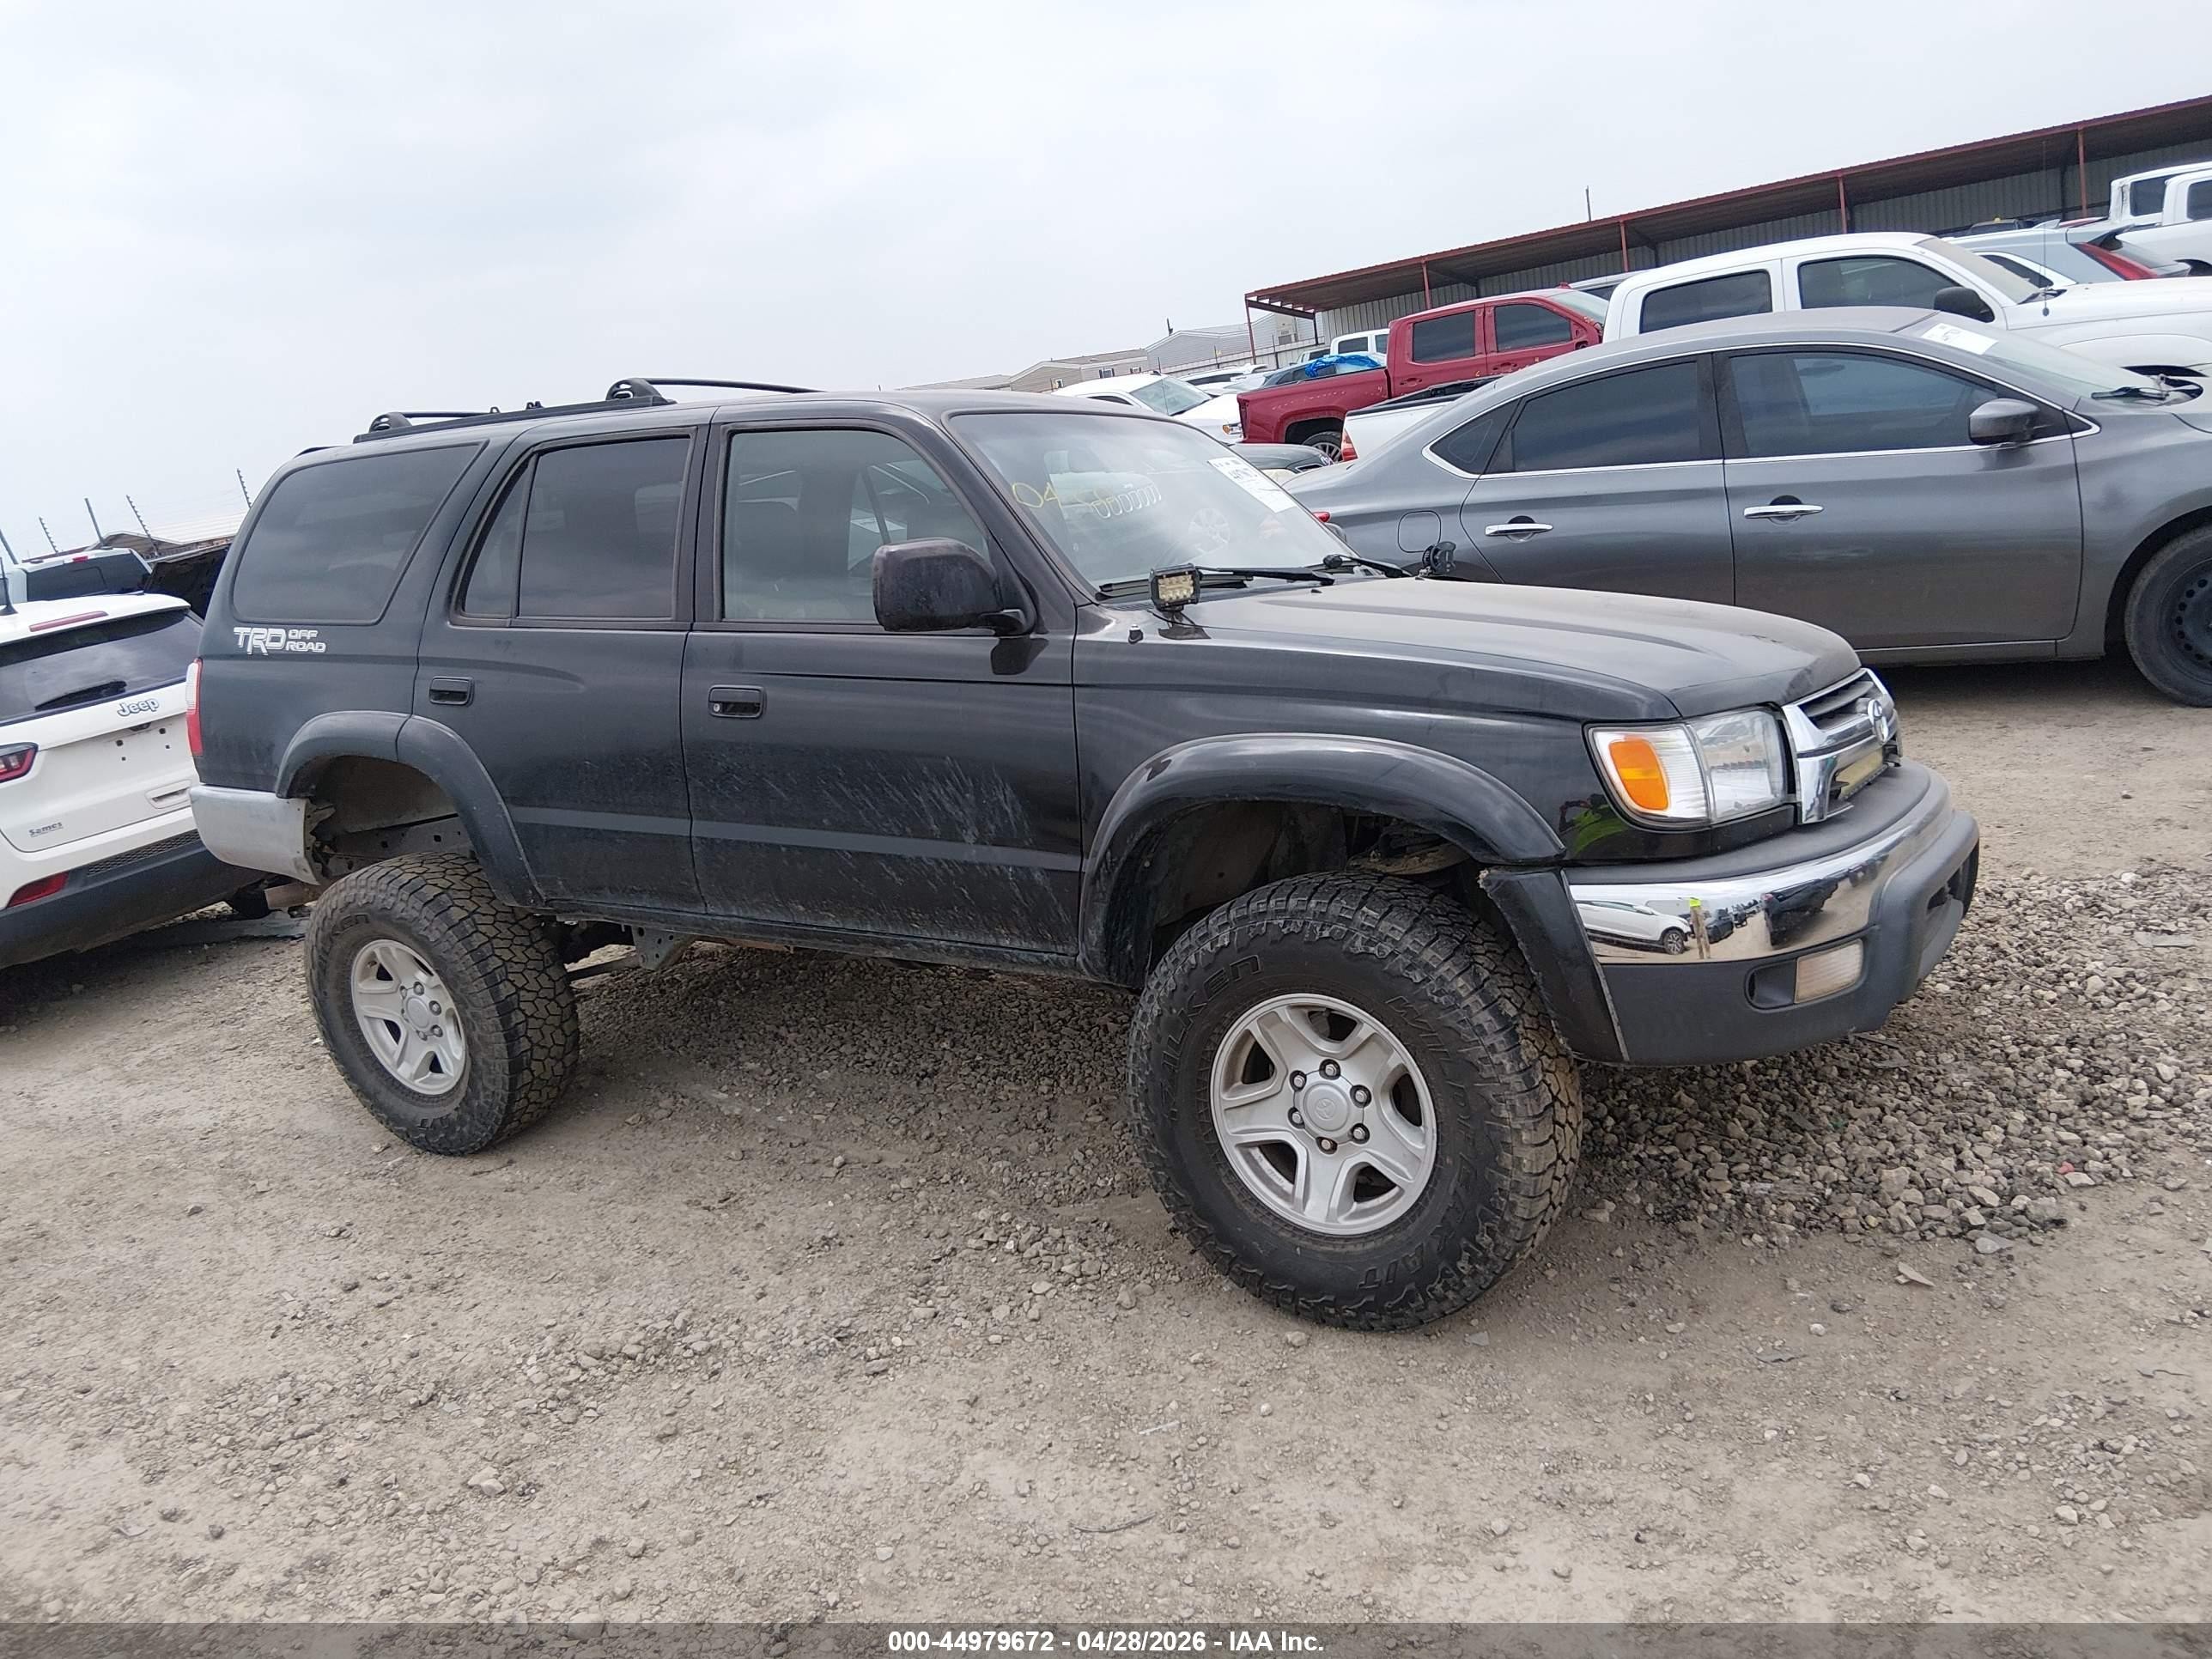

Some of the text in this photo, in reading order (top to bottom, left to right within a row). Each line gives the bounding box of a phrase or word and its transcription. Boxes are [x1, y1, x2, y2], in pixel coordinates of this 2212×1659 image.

[234, 627, 319, 655] TRD OFF
[285, 641, 326, 653] ROAD
[117, 698, 160, 717] Jeep
